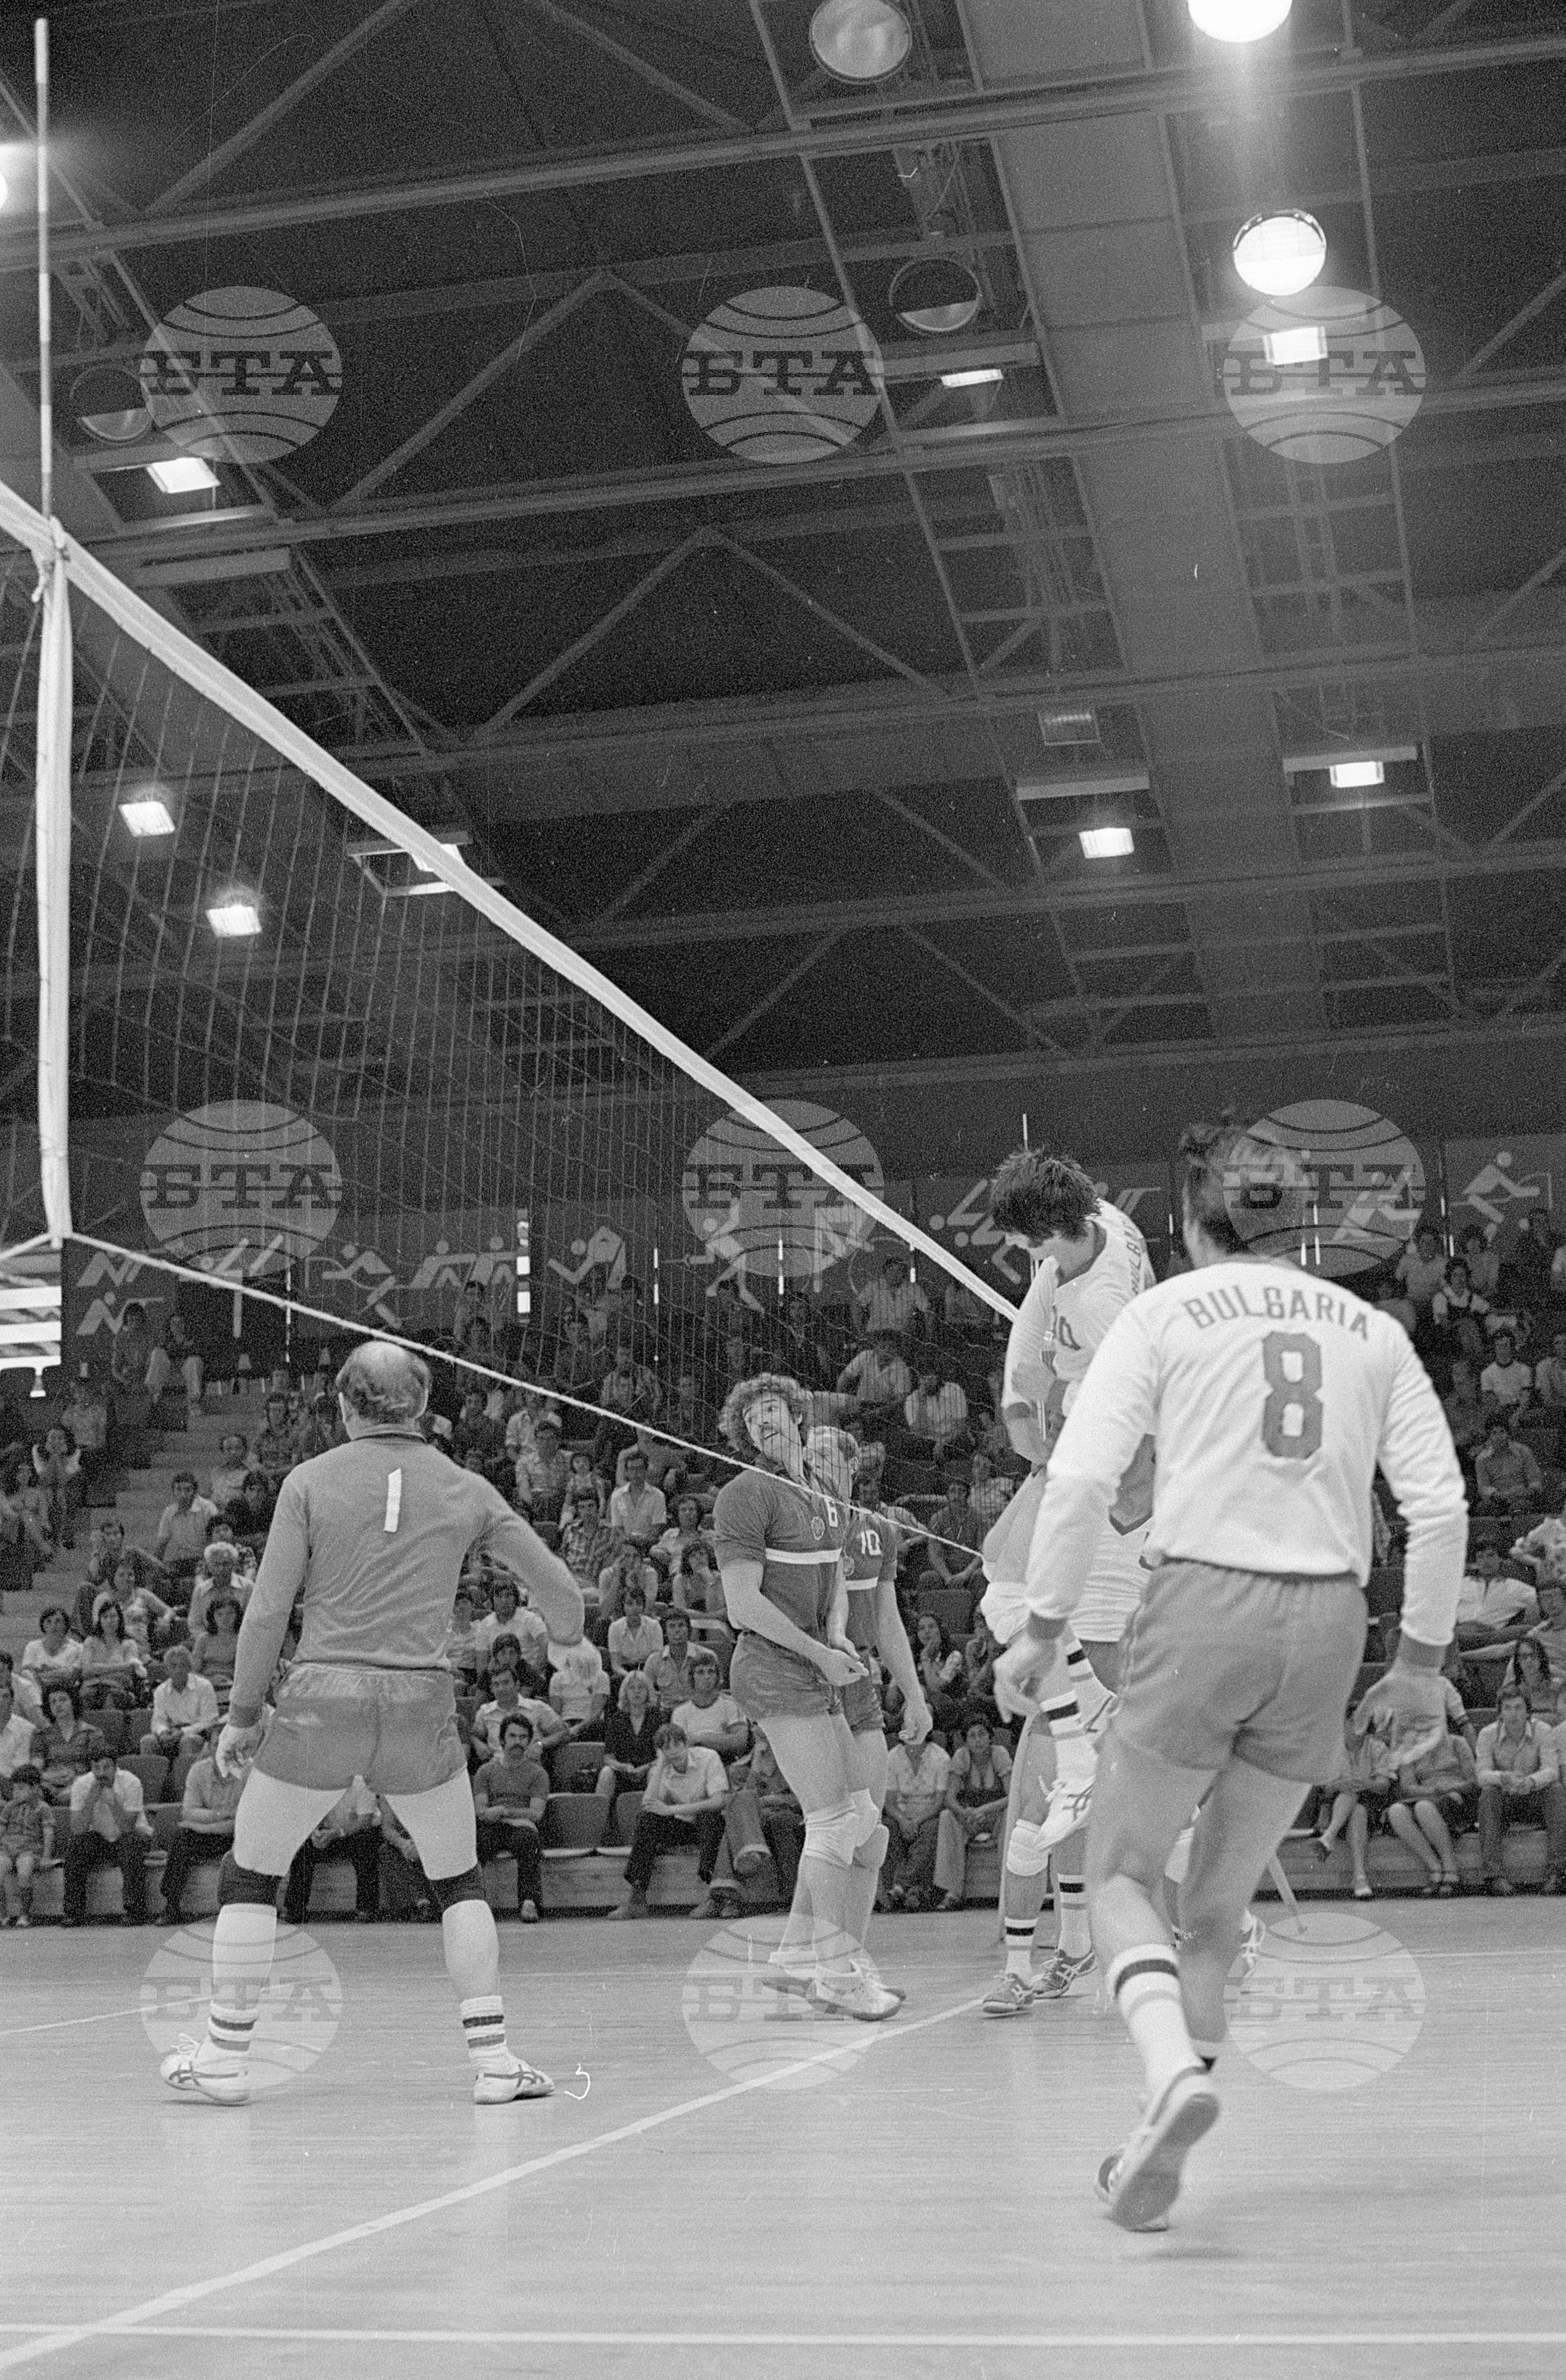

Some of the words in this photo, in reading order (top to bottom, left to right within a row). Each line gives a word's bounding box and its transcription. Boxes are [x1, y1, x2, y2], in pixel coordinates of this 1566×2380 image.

[1183, 1285, 1368, 1341] BULGARIA
[1261, 1330, 1324, 1460] 8
[383, 1467, 402, 1533] 1
[860, 1529, 881, 1556] 10
